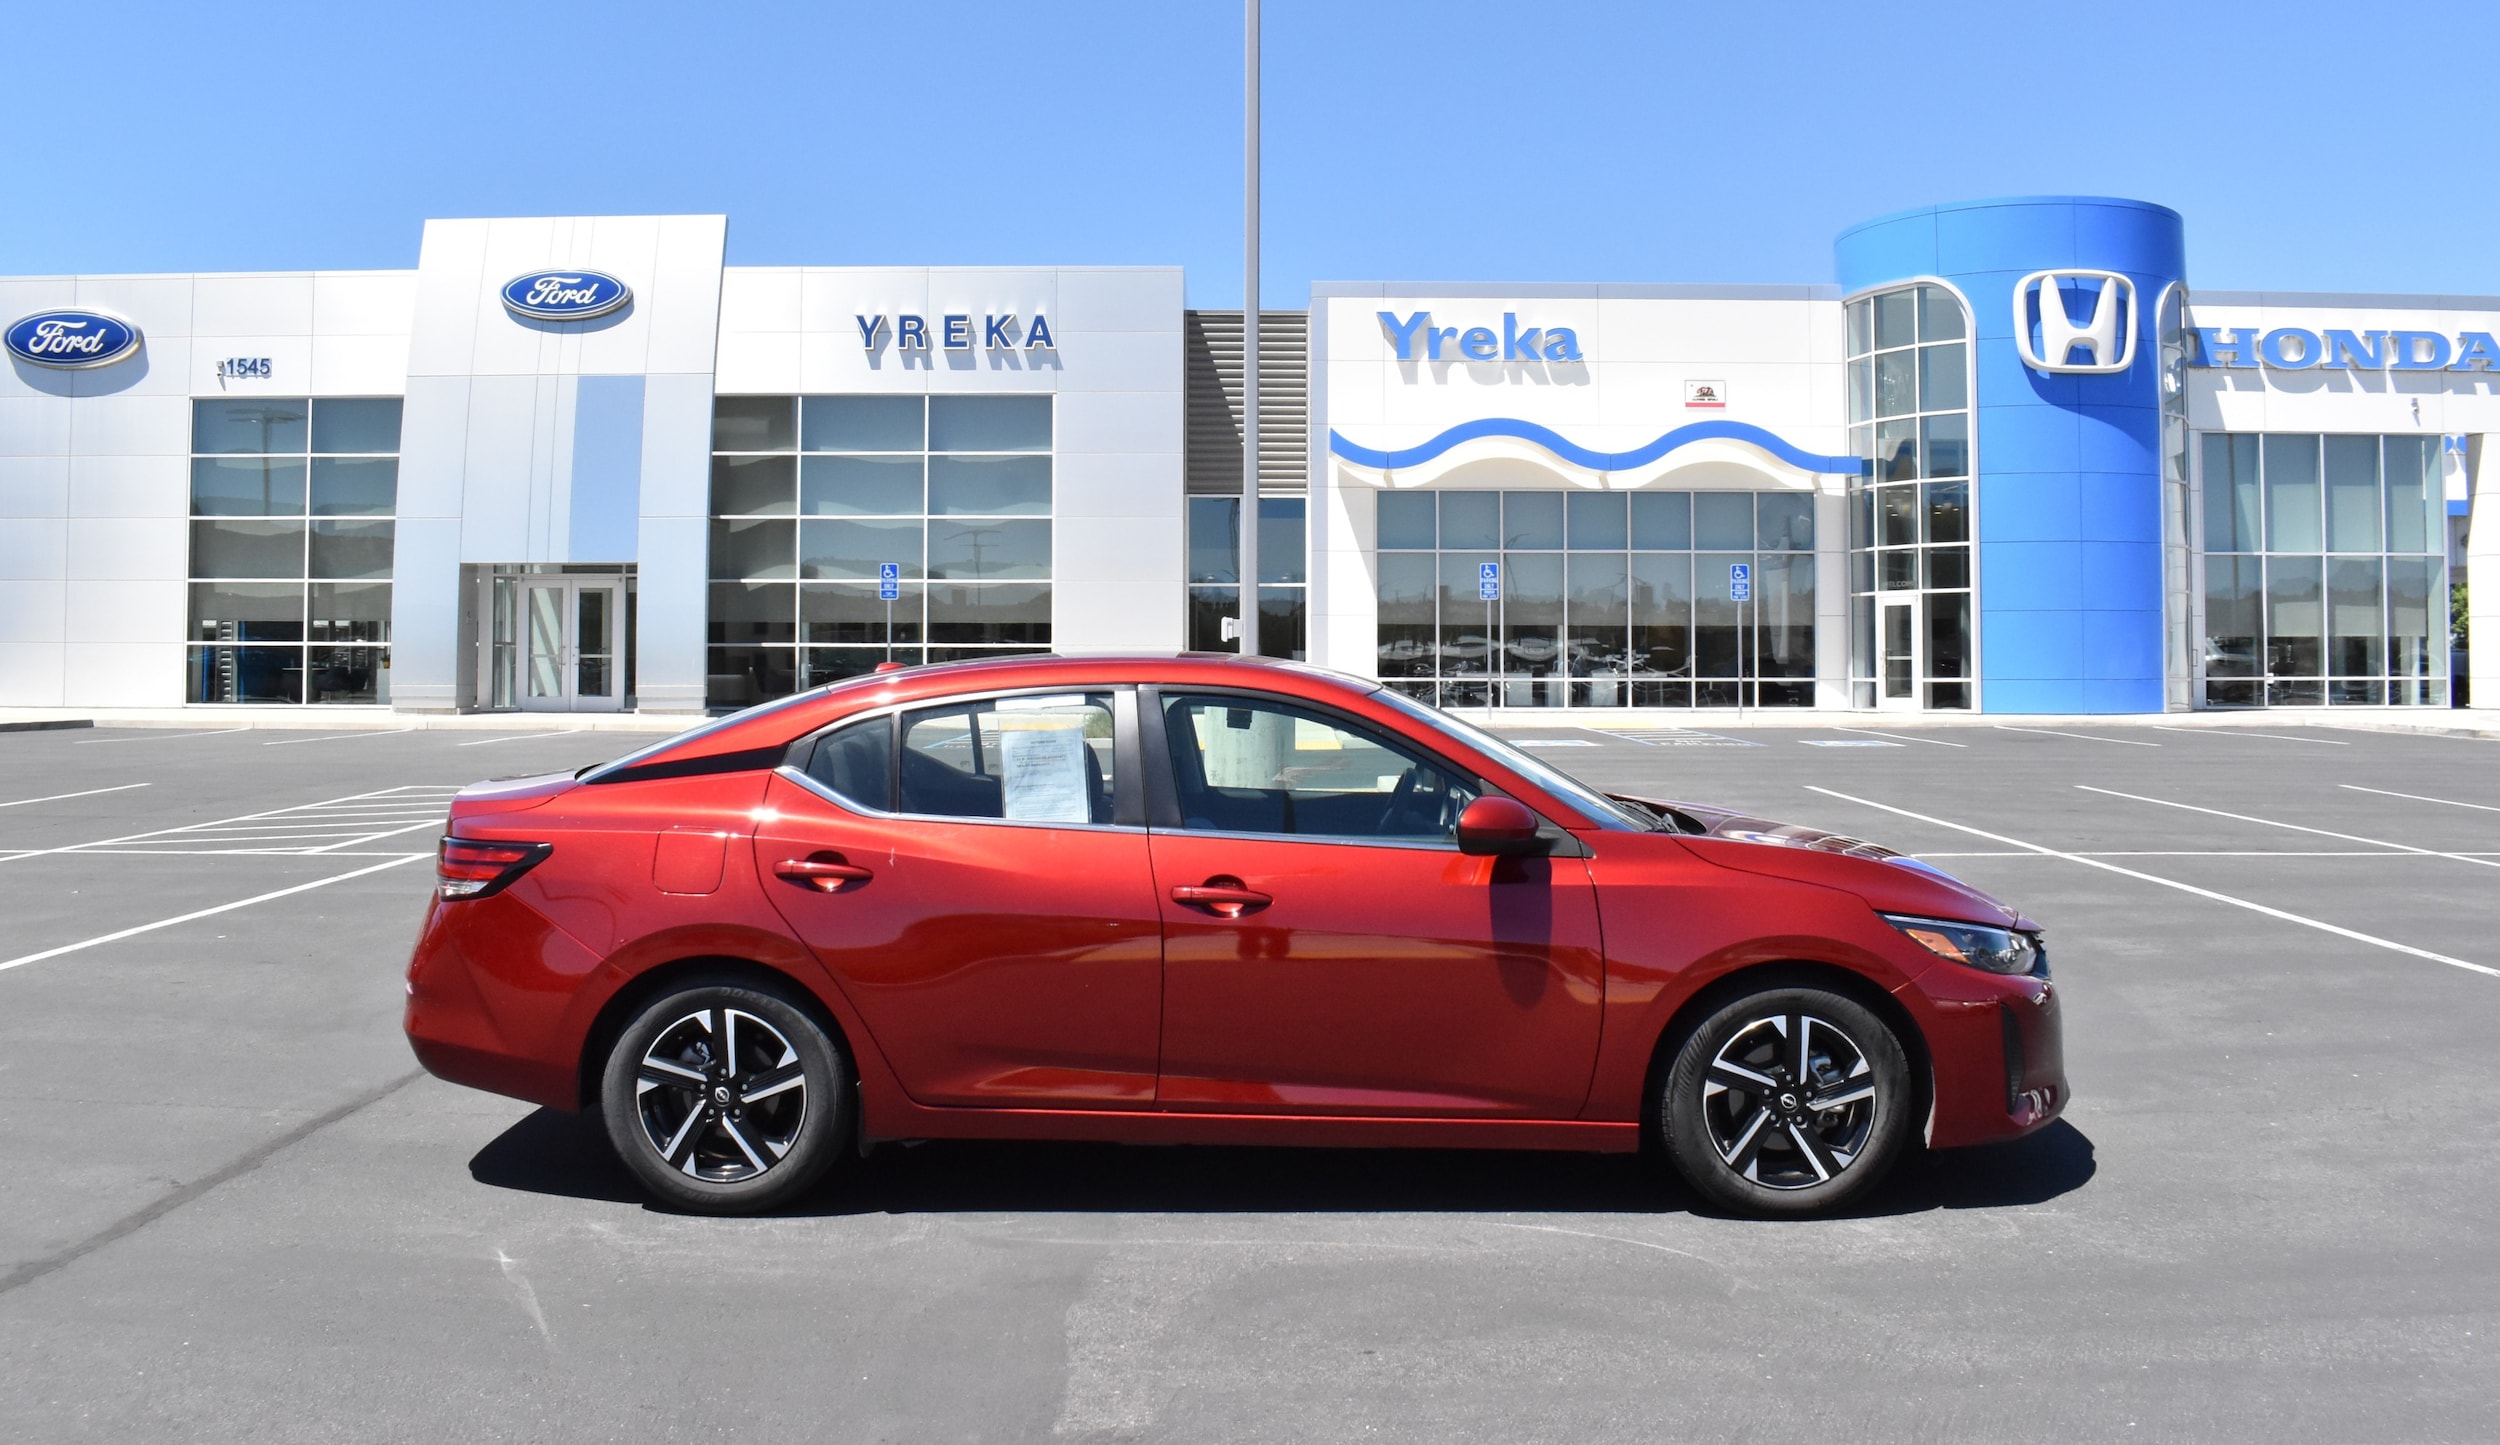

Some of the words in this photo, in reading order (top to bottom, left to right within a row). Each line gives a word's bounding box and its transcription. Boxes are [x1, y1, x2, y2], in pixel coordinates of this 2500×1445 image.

[526, 276, 600, 305] Ford
[28, 320, 107, 354] Ford
[854, 313, 1057, 350] YREKA
[1376, 311, 1584, 361] Yreka
[2188, 327, 2500, 371] HONDA
[227, 358, 270, 375] 1545
